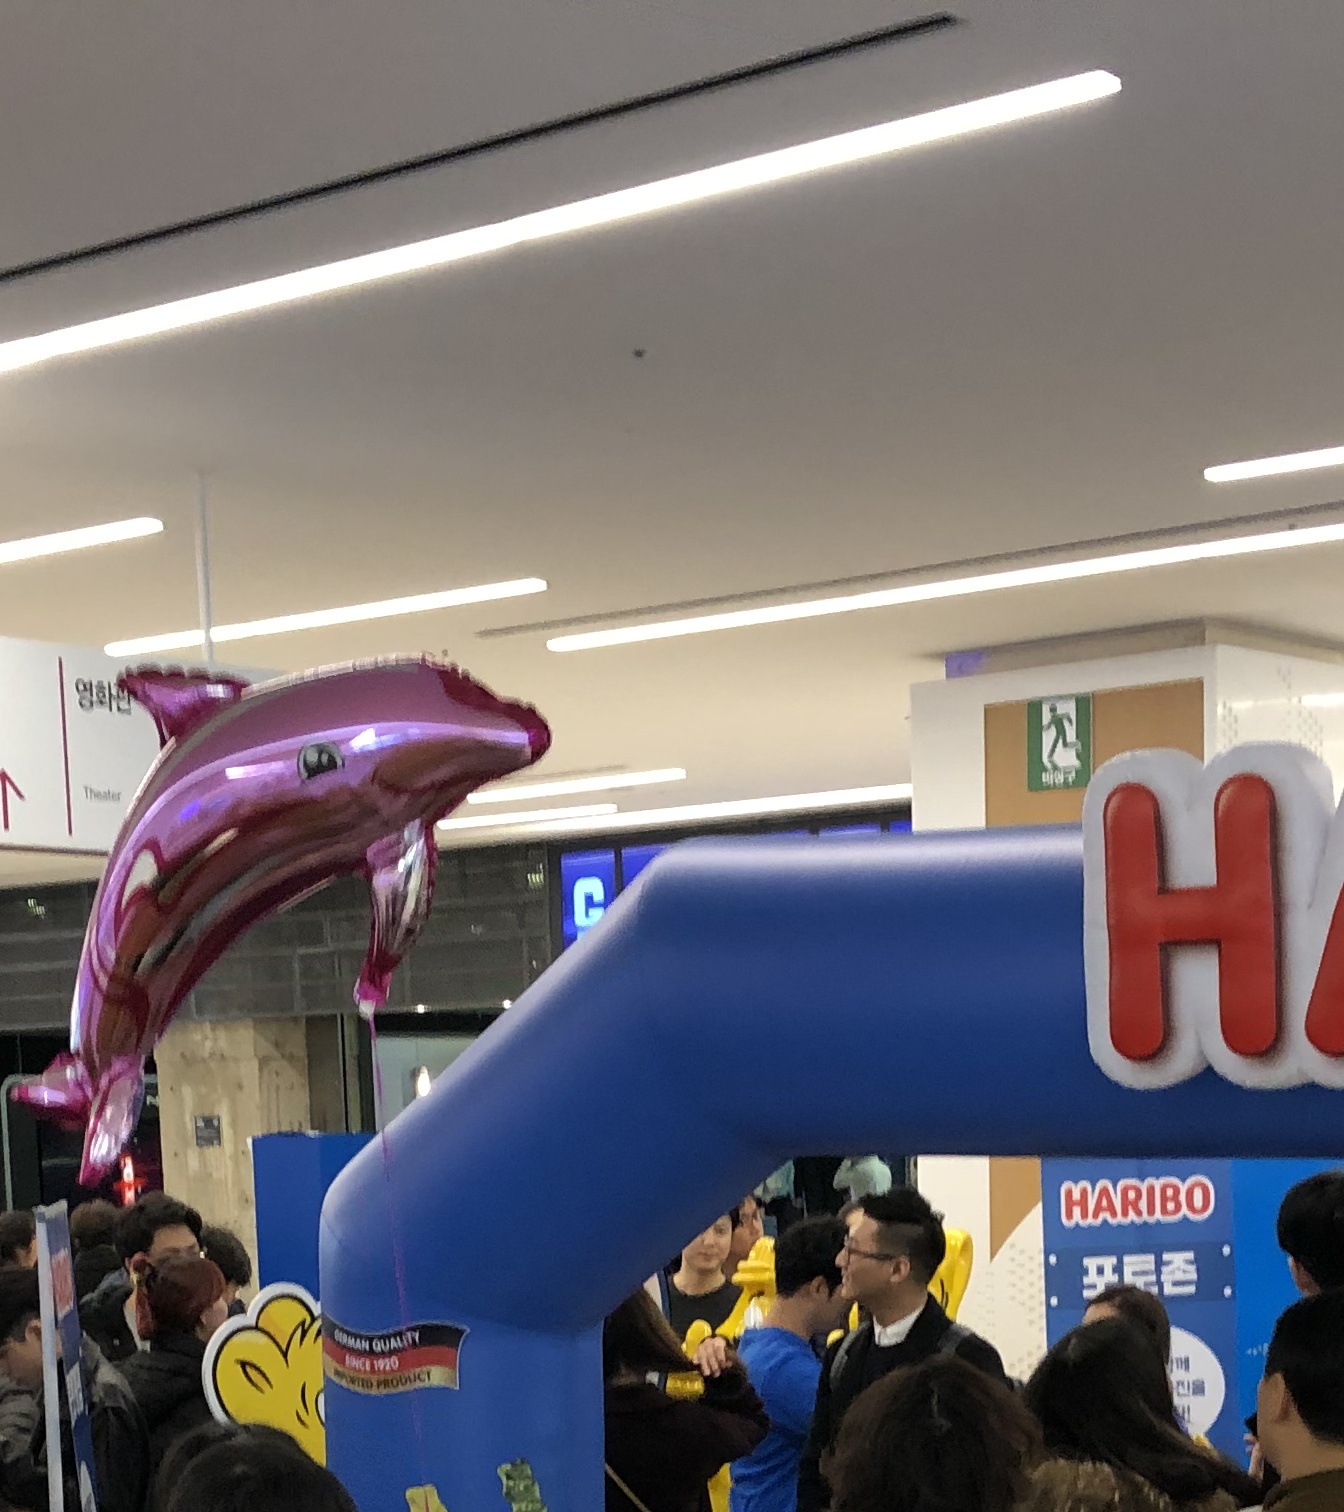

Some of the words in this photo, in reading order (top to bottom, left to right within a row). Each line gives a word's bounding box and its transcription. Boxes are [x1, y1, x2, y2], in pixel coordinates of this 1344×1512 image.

[83, 785, 122, 802] Theater
[1063, 1177, 1213, 1225] HARIBO
[1083, 1250, 1197, 1299] 포토존
[334, 1329, 370, 1352] GERMAN
[372, 1329, 420, 1353] QUALITY
[345, 1354, 370, 1371] SINCE
[374, 1355, 399, 1371] 1920
[333, 1367, 374, 1390] IMPORTED
[376, 1370, 431, 1390] PRODUCT
